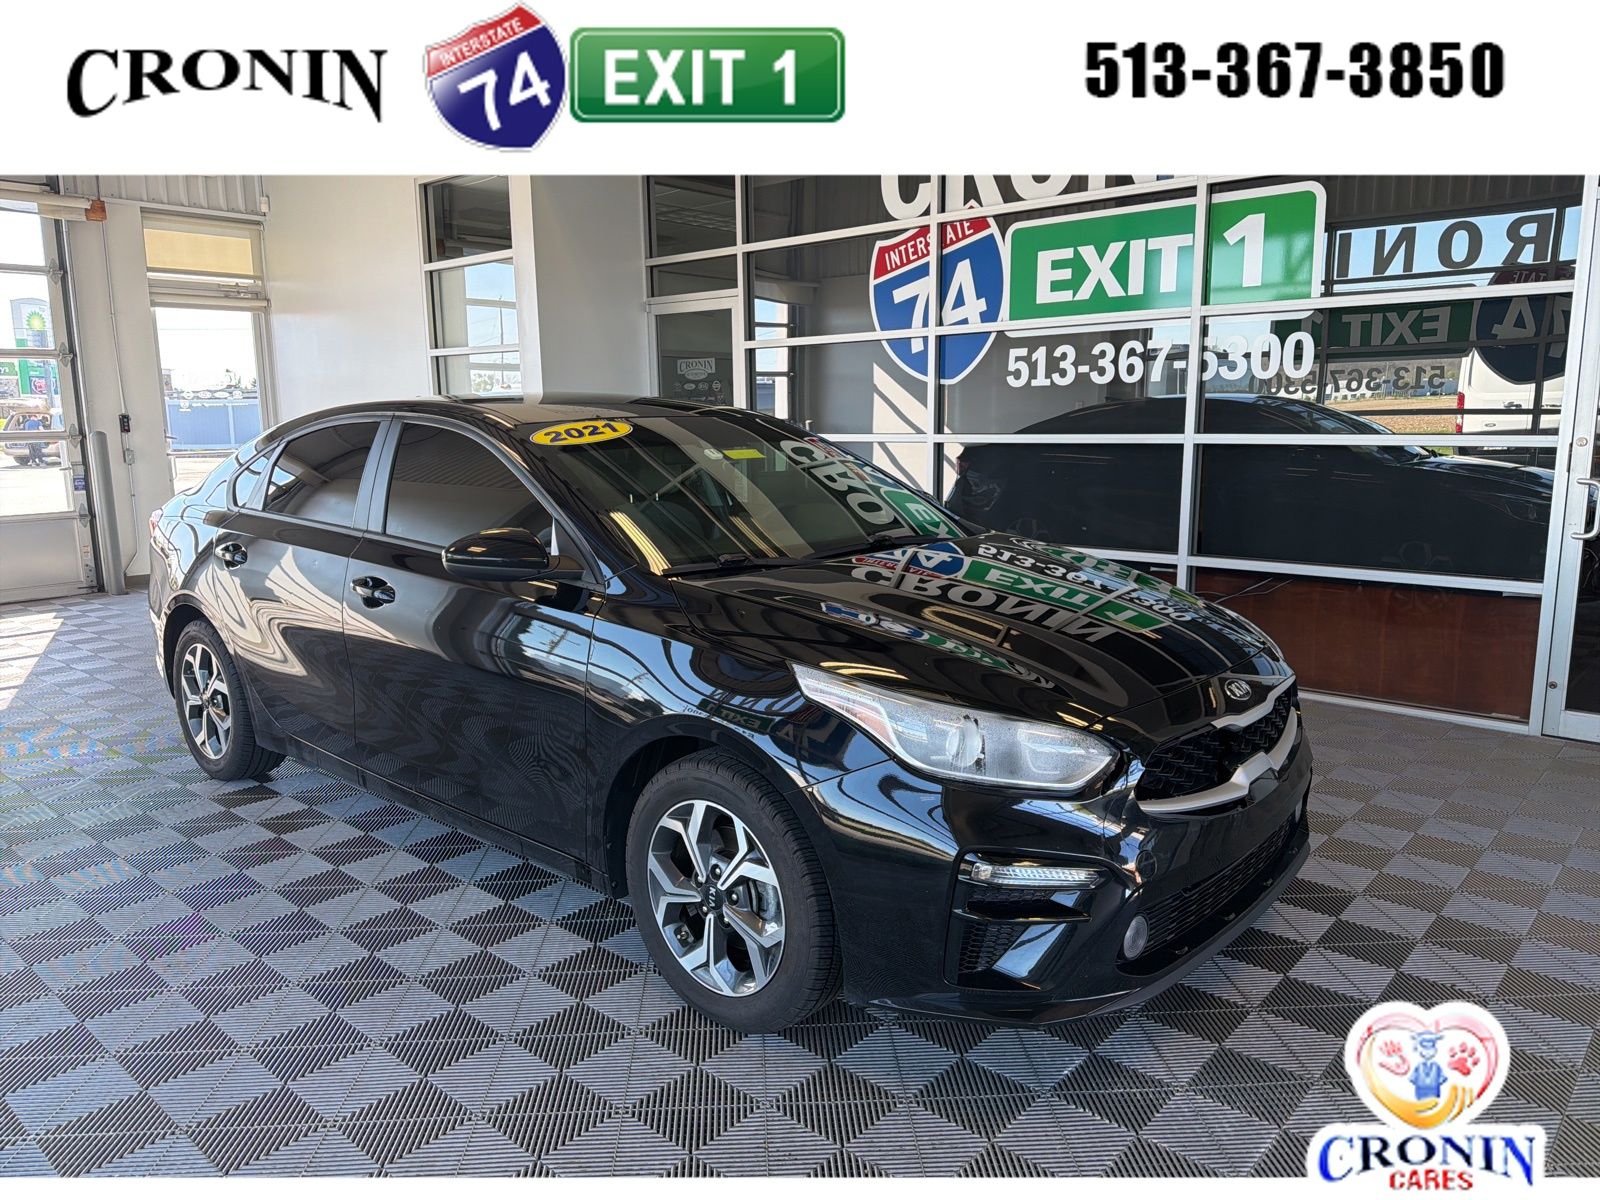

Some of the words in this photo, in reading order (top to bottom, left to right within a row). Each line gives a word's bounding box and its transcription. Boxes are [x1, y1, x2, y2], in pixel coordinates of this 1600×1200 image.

[885, 220, 974, 270] INTERATE
[1036, 233, 1194, 304] EXIT
[1223, 213, 1265, 287] 1
[892, 258, 988, 354] 74
[680, 359, 713, 373] CRONIN
[544, 422, 620, 443] 2021
